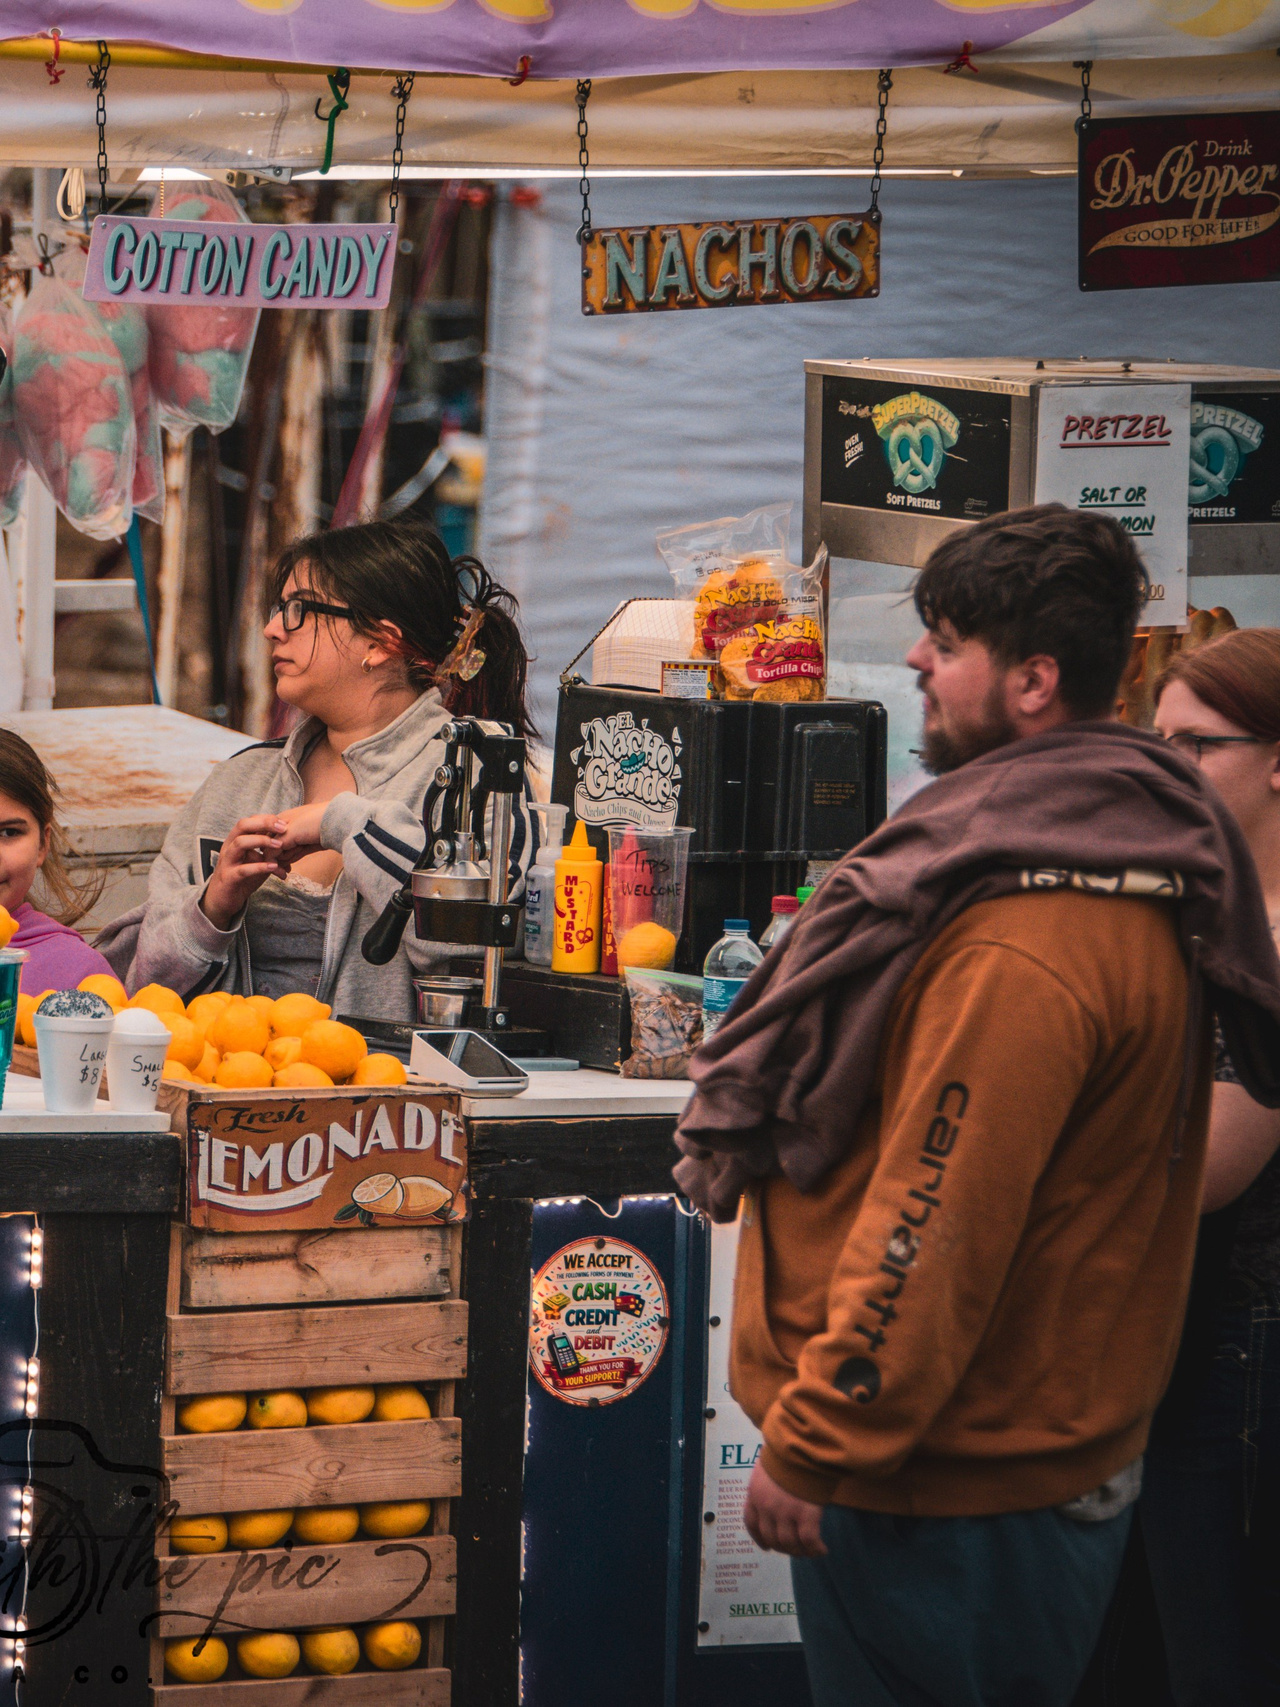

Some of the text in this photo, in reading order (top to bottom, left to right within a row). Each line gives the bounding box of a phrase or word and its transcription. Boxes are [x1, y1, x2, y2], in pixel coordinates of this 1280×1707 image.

[1203, 138, 1253, 158] Drink
[1124, 227, 1179, 243] GOOD
[1182, 223, 1217, 239] FOR
[102, 222, 389, 300] COTTON CANDY
[600, 219, 865, 311] NACHOS
[1062, 414, 1172, 442] PRETZEL
[1191, 401, 1265, 444] PRETZEL
[844, 433, 860, 450] OVEN
[844, 441, 864, 462] FRESH!
[886, 492, 941, 511] SOFT PRETZELS
[1079, 486, 1148, 503] SALT OR
[755, 663, 798, 679] Tortilla
[617, 712, 635, 730] EL
[584, 756, 672, 805] Grande
[606, 801, 628, 815] Chips
[621, 881, 682, 897] WELCOME
[563, 875, 579, 954] MUSTARD
[79, 1065, 100, 1085] $8
[213, 1104, 310, 1134] Fresh
[197, 1101, 465, 1212] LEMONADE
[853, 1080, 970, 1353] carhartt
[563, 1252, 633, 1269] WE ACCEPT
[572, 1282, 617, 1301] CASH
[565, 1309, 621, 1327] CREDIT
[586, 1326, 602, 1335] and
[574, 1335, 616, 1351] DEBIT
[579, 1361, 624, 1374] THANK YOU FOR
[564, 1371, 621, 1386] YOUR SUPPORT!
[729, 1602, 795, 1616] SHAVE ICE
